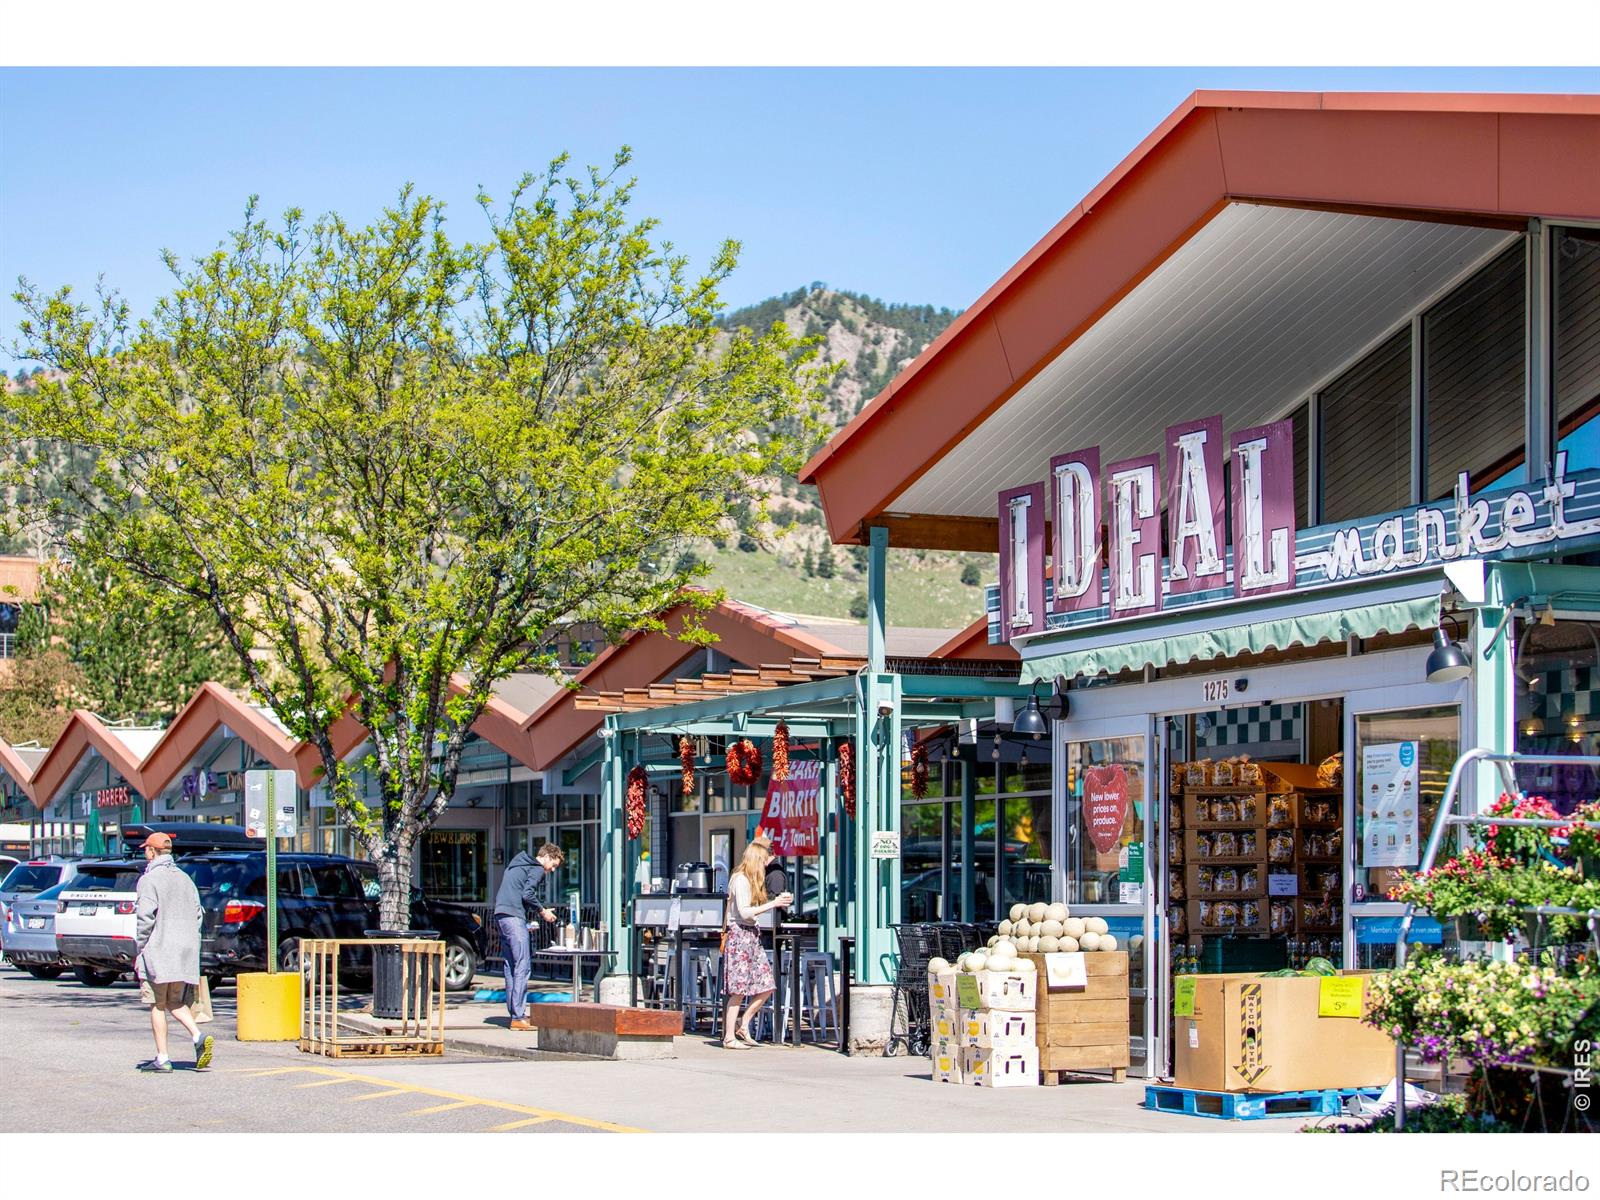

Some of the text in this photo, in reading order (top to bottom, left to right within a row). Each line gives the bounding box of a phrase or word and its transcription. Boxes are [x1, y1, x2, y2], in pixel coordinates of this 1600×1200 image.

[1297, 450, 1600, 581] market
[1006, 430, 1289, 629] IDEAL
[1204, 681, 1229, 701] 1275
[97, 786, 130, 808] BARBERS
[768, 789, 821, 818] BURRIT
[1090, 791, 1120, 802] New lower
[1092, 804, 1109, 816] prices
[428, 832, 477, 844] JEWELERS
[1247, 996, 1255, 1026] WATCH
